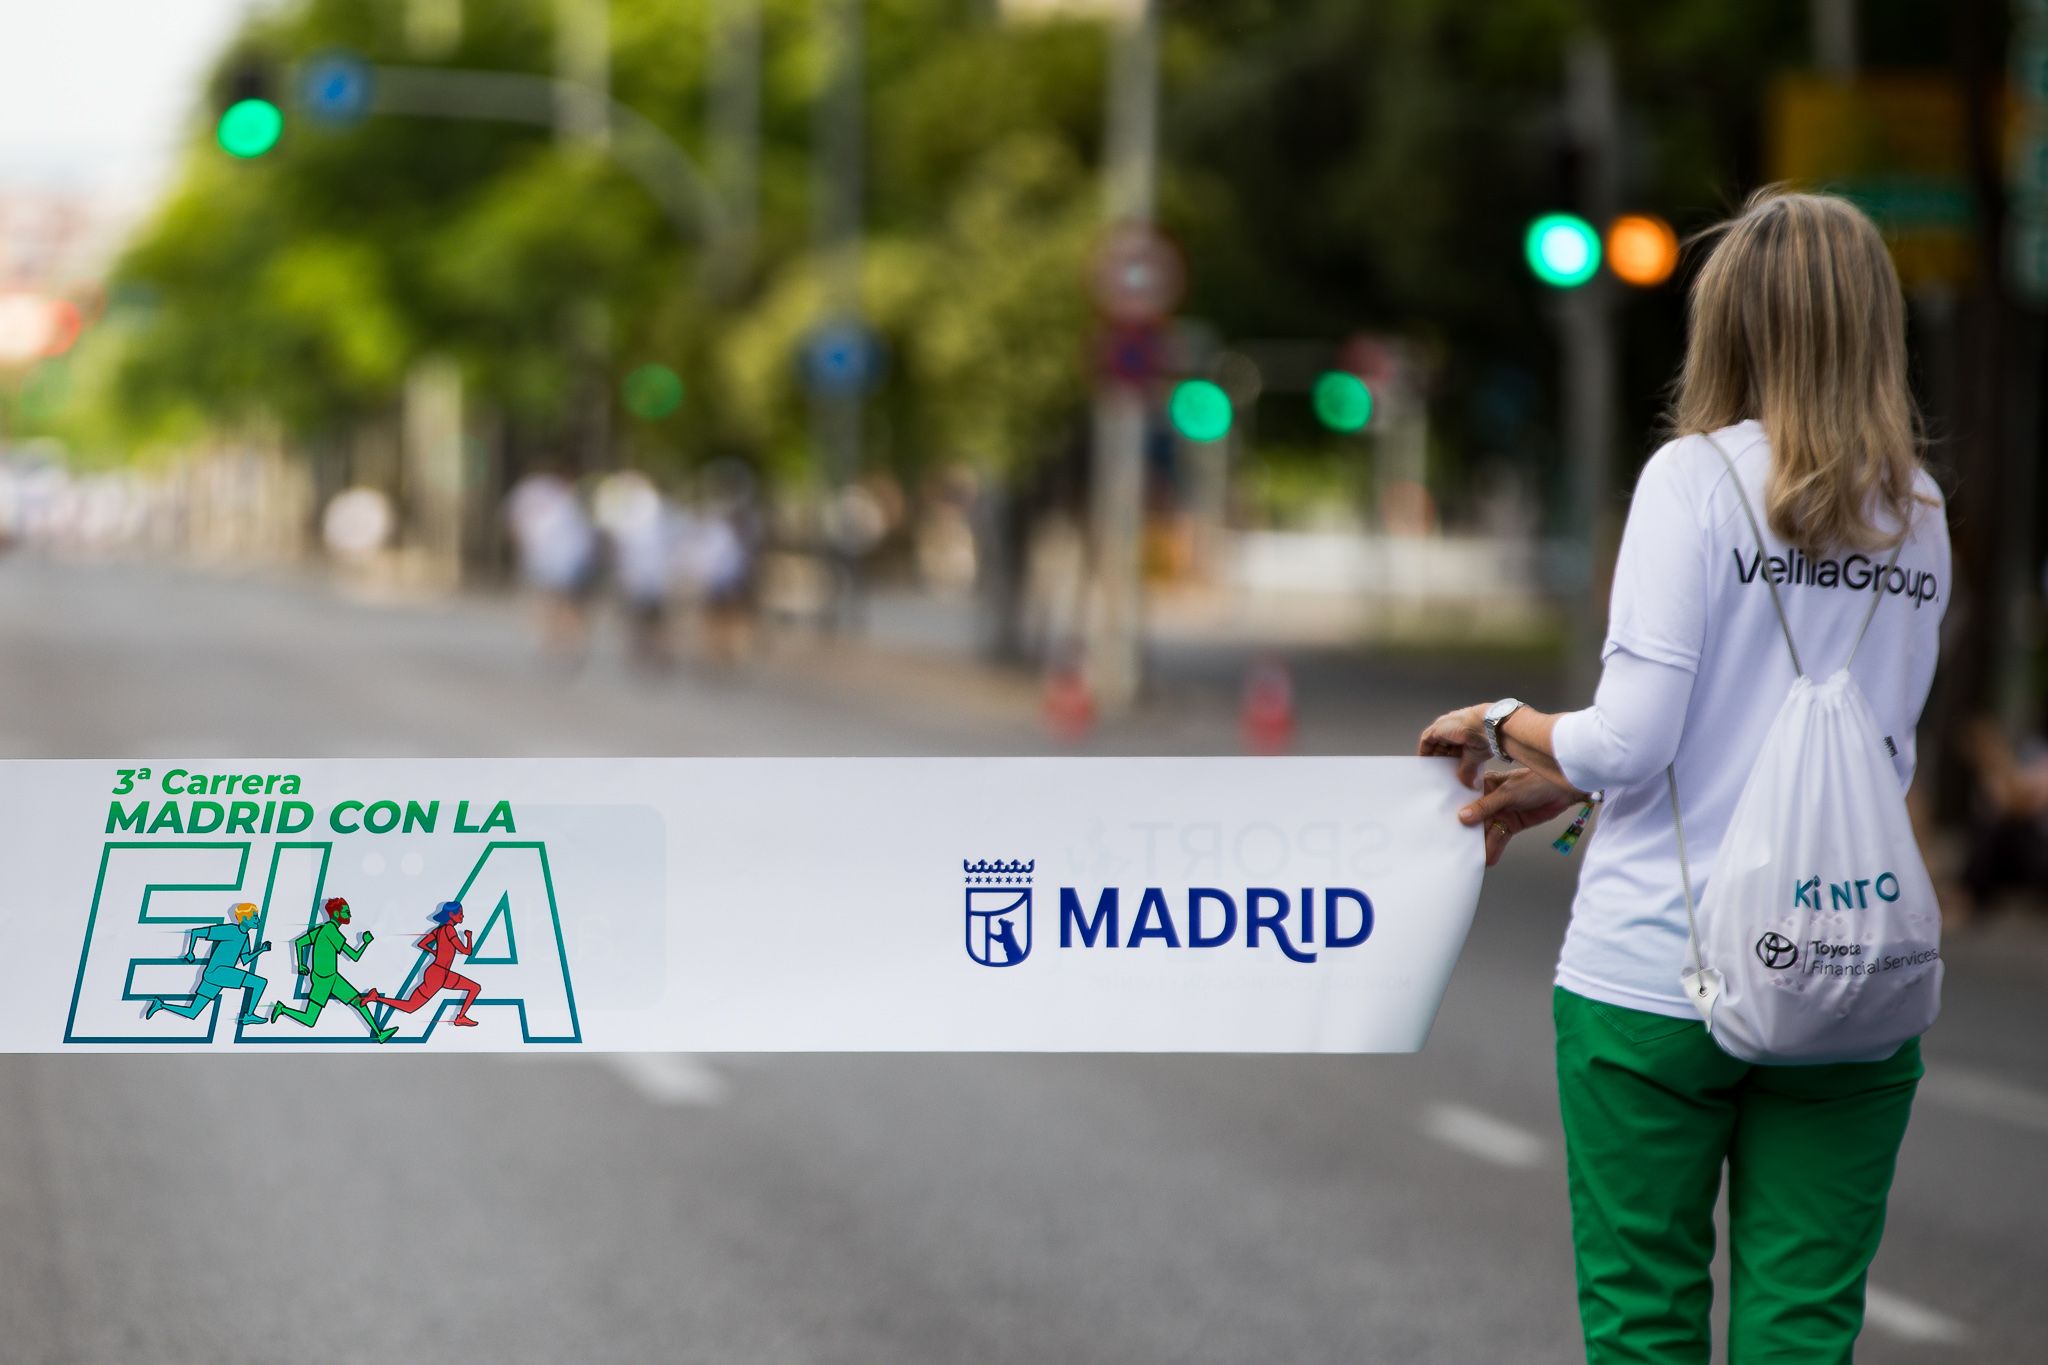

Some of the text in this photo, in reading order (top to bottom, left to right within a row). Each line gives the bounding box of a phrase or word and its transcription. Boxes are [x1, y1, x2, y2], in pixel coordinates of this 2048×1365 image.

[161, 769, 301, 795] Carrera
[104, 800, 517, 834] MADRID CON LA
[1060, 887, 1375, 963] MADRID
[63, 841, 582, 1043] ELA
[1811, 940, 1862, 957] Toyota
[1811, 948, 1938, 976] Financial Services
